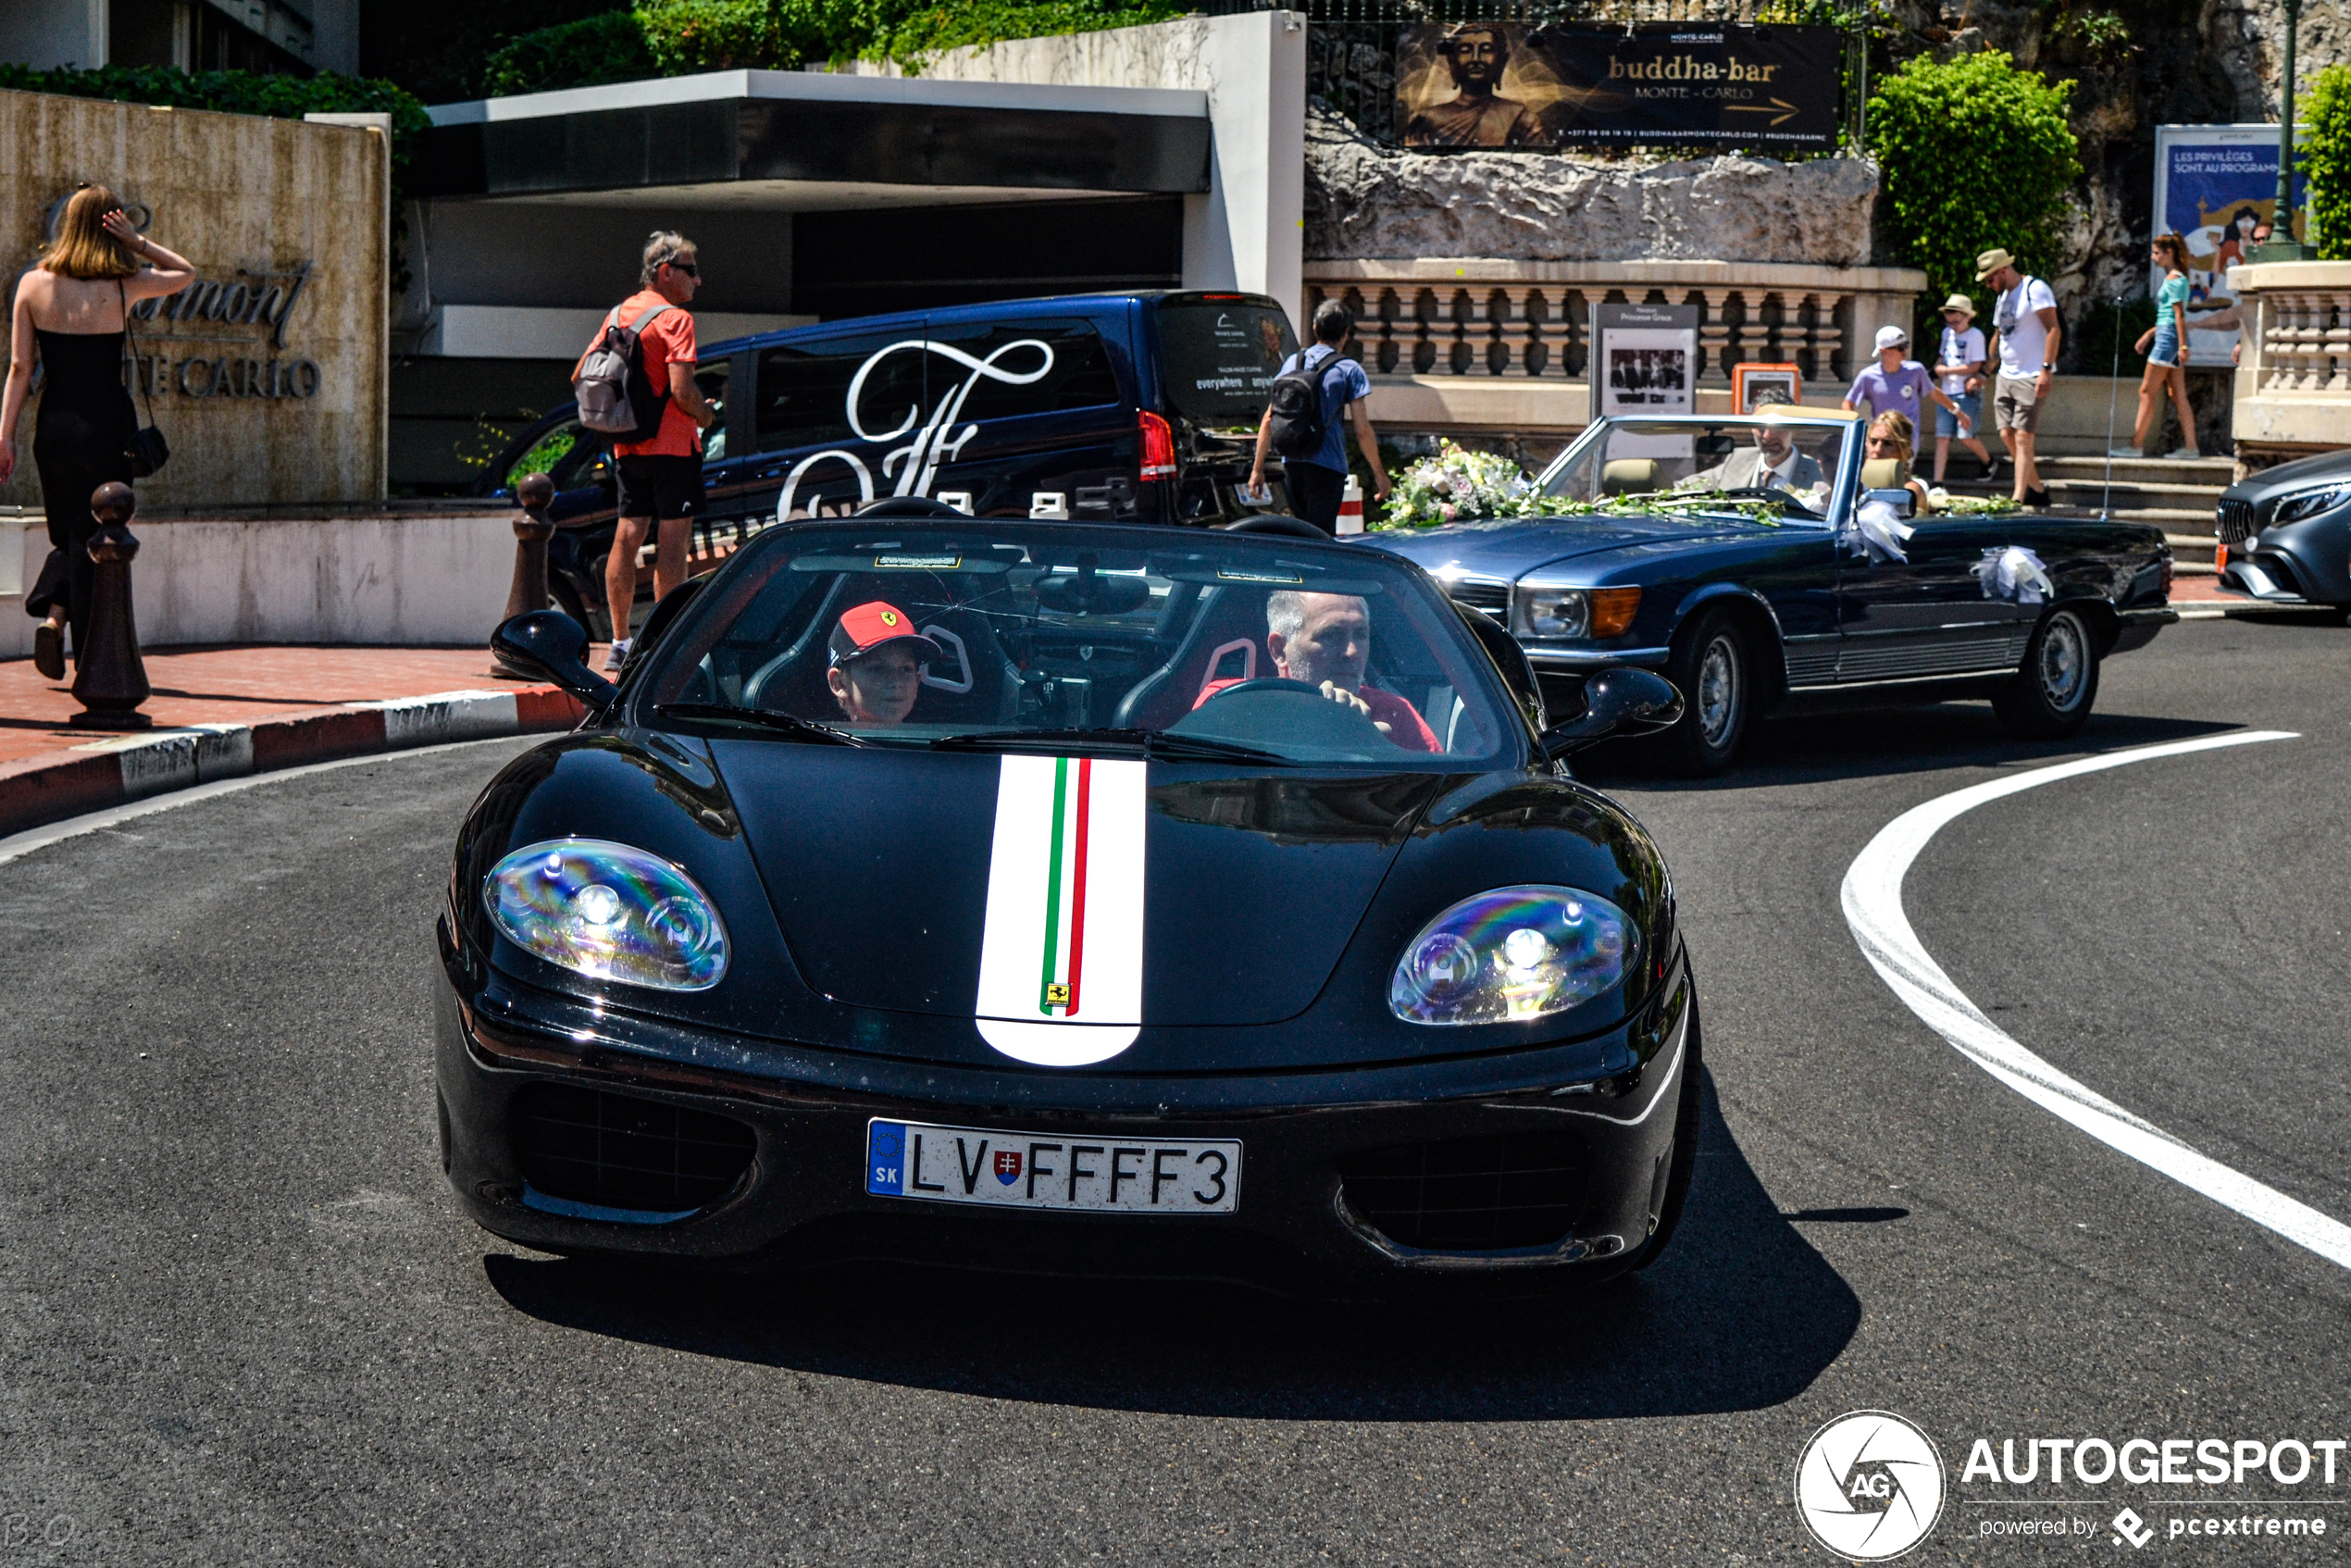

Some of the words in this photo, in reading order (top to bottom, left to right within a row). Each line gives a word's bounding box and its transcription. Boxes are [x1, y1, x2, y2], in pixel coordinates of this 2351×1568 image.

[1609, 55, 1776, 82] buddha-bar
[1635, 87, 1689, 99] MONTE
[1701, 88, 1754, 100] CARLO
[2174, 151, 2193, 162] LES
[2194, 148, 2254, 162] PRIVILÈGES
[2174, 162, 2203, 173] SONT
[2205, 163, 2220, 173] AU
[180, 357, 322, 399] CARLO
[1196, 377, 1243, 391] everywhere
[876, 1166, 898, 1184] SK
